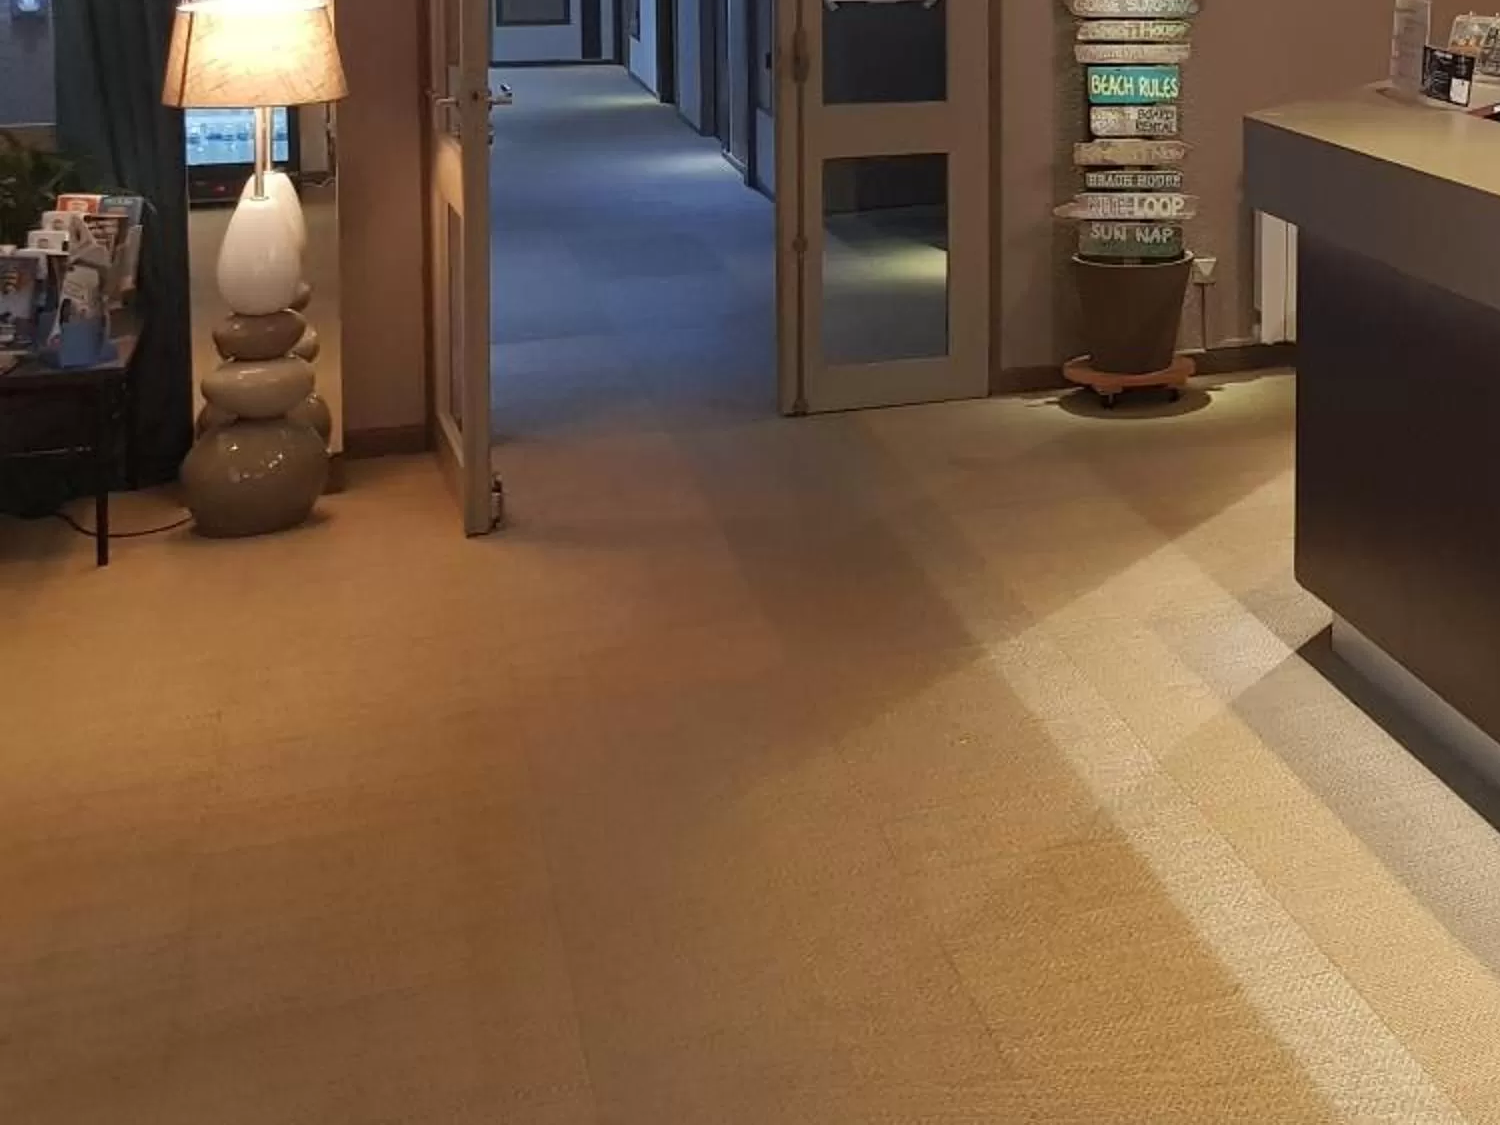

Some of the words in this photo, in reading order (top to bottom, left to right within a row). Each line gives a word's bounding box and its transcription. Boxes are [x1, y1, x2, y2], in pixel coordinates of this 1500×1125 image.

[1091, 74, 1134, 96] BEACH
[1139, 76, 1179, 98] RULES
[1091, 222, 1127, 241] SUN
[1135, 225, 1174, 244] NAP
